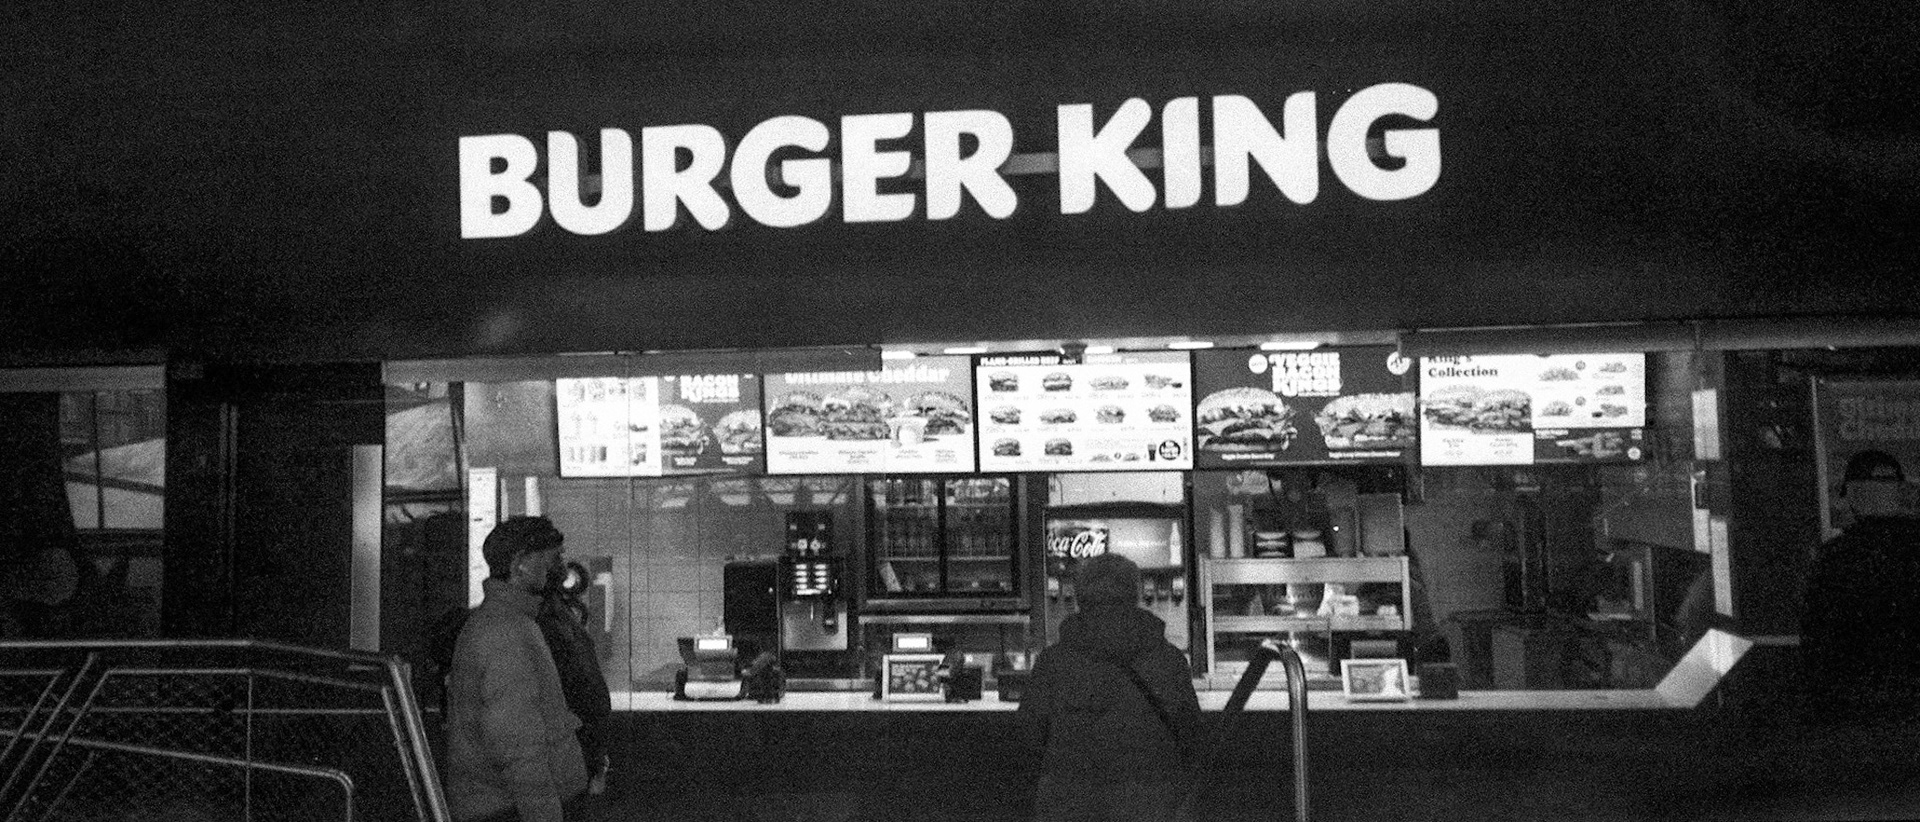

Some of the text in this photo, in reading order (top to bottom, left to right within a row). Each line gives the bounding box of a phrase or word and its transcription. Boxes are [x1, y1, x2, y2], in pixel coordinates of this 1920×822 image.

[459, 82, 1442, 239] BURGER KING
[1428, 365, 1498, 378] Collection
